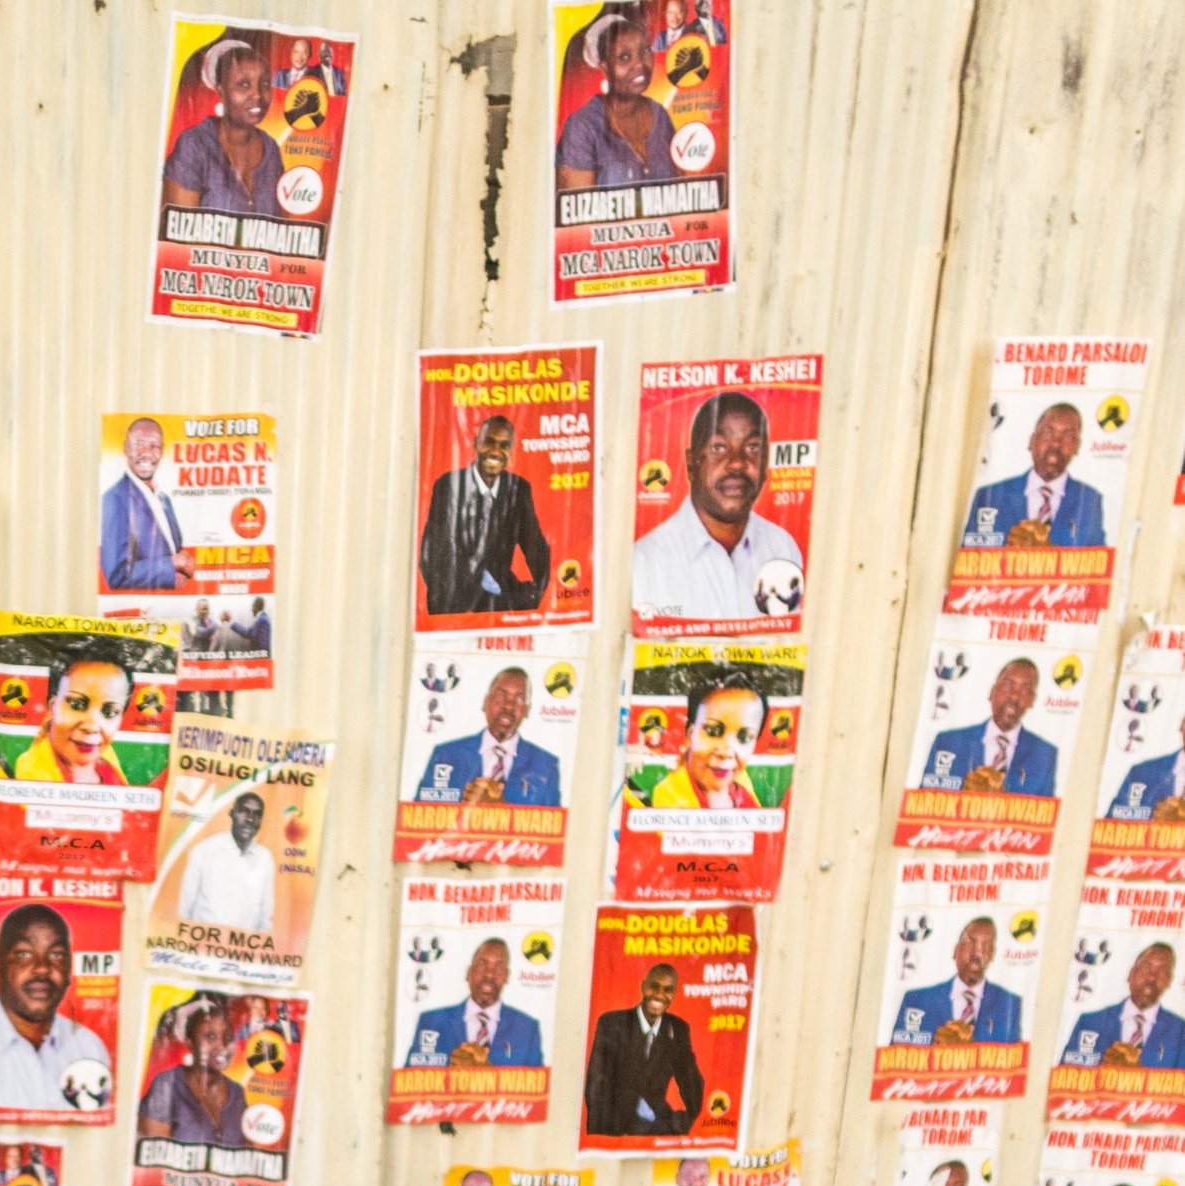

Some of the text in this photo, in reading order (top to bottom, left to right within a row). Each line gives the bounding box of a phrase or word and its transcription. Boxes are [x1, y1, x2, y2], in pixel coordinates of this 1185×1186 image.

[560, 179, 721, 226] ELIZABETH WAMAITHA
[240, 218, 321, 258] WAMAITHA
[590, 219, 709, 245] MUNYUA FOR
[190, 247, 307, 276] MUNYUA FOR
[667, 236, 721, 269] TOWN
[159, 268, 315, 311] MCA TOWN
[582, 273, 699, 292] TOGETHER WE STRONG
[220, 305, 253, 318] WE ARE
[1003, 342, 1148, 365] BENARD PARSALOI
[454, 357, 563, 383] DOUGLAS
[643, 357, 817, 389] NELSON K. KESHEI
[1022, 365, 1089, 386] TOROME
[453, 380, 591, 409] MASIKONDE
[184, 418, 259, 439] VOTE FOR
[540, 413, 590, 436] MCA
[173, 440, 273, 465] LUCAS N.
[521, 437, 591, 455] TOWNSHIP
[774, 442, 812, 467] MP
[549, 451, 591, 465] WARD
[178, 465, 266, 488] KUDATE
[549, 472, 590, 490] 2017
[195, 545, 271, 566] MCA
[1004, 549, 1058, 576] TOWN
[656, 604, 684, 617] VOTE
[12, 612, 119, 639] NAROK TOWN
[690, 621, 711, 635] AND
[989, 620, 1049, 642] TOROME
[654, 645, 711, 662] NAROK
[540, 705, 577, 722] Jubilee
[256, 738, 284, 763] OLE
[179, 754, 260, 783] OSILIGI
[264, 767, 316, 788] LANG
[57, 788, 119, 804] MAUREEN
[124, 792, 156, 805] SETH
[402, 804, 564, 835] NAROK TOWN WARD
[633, 811, 692, 826] FLORENCE
[39, 835, 106, 851] M.C.A
[279, 861, 316, 877] (NASA)
[675, 862, 739, 873] M.C.A
[933, 863, 989, 882] BENARD
[408, 882, 564, 903] HON. BENARD PARSALOI
[626, 913, 729, 934] DOUGLAS
[177, 922, 275, 952] FOR MCA
[624, 934, 752, 957] MASIKONDE
[81, 952, 114, 974] MP
[146, 936, 303, 969] NAROK TOWN WARD
[218, 960, 295, 983] Pamoja
[519, 969, 556, 982] Jubilee
[703, 964, 749, 984] MCA
[682, 984, 749, 999] TOWNSHIP
[708, 1013, 746, 1032] 2017
[499, 1069, 548, 1094] WARD
[702, 1112, 740, 1130] Jubilee
[909, 1107, 962, 1128] BENARD
[1048, 1129, 1079, 1149] HON.
[1090, 1150, 1148, 1171] TOROME
